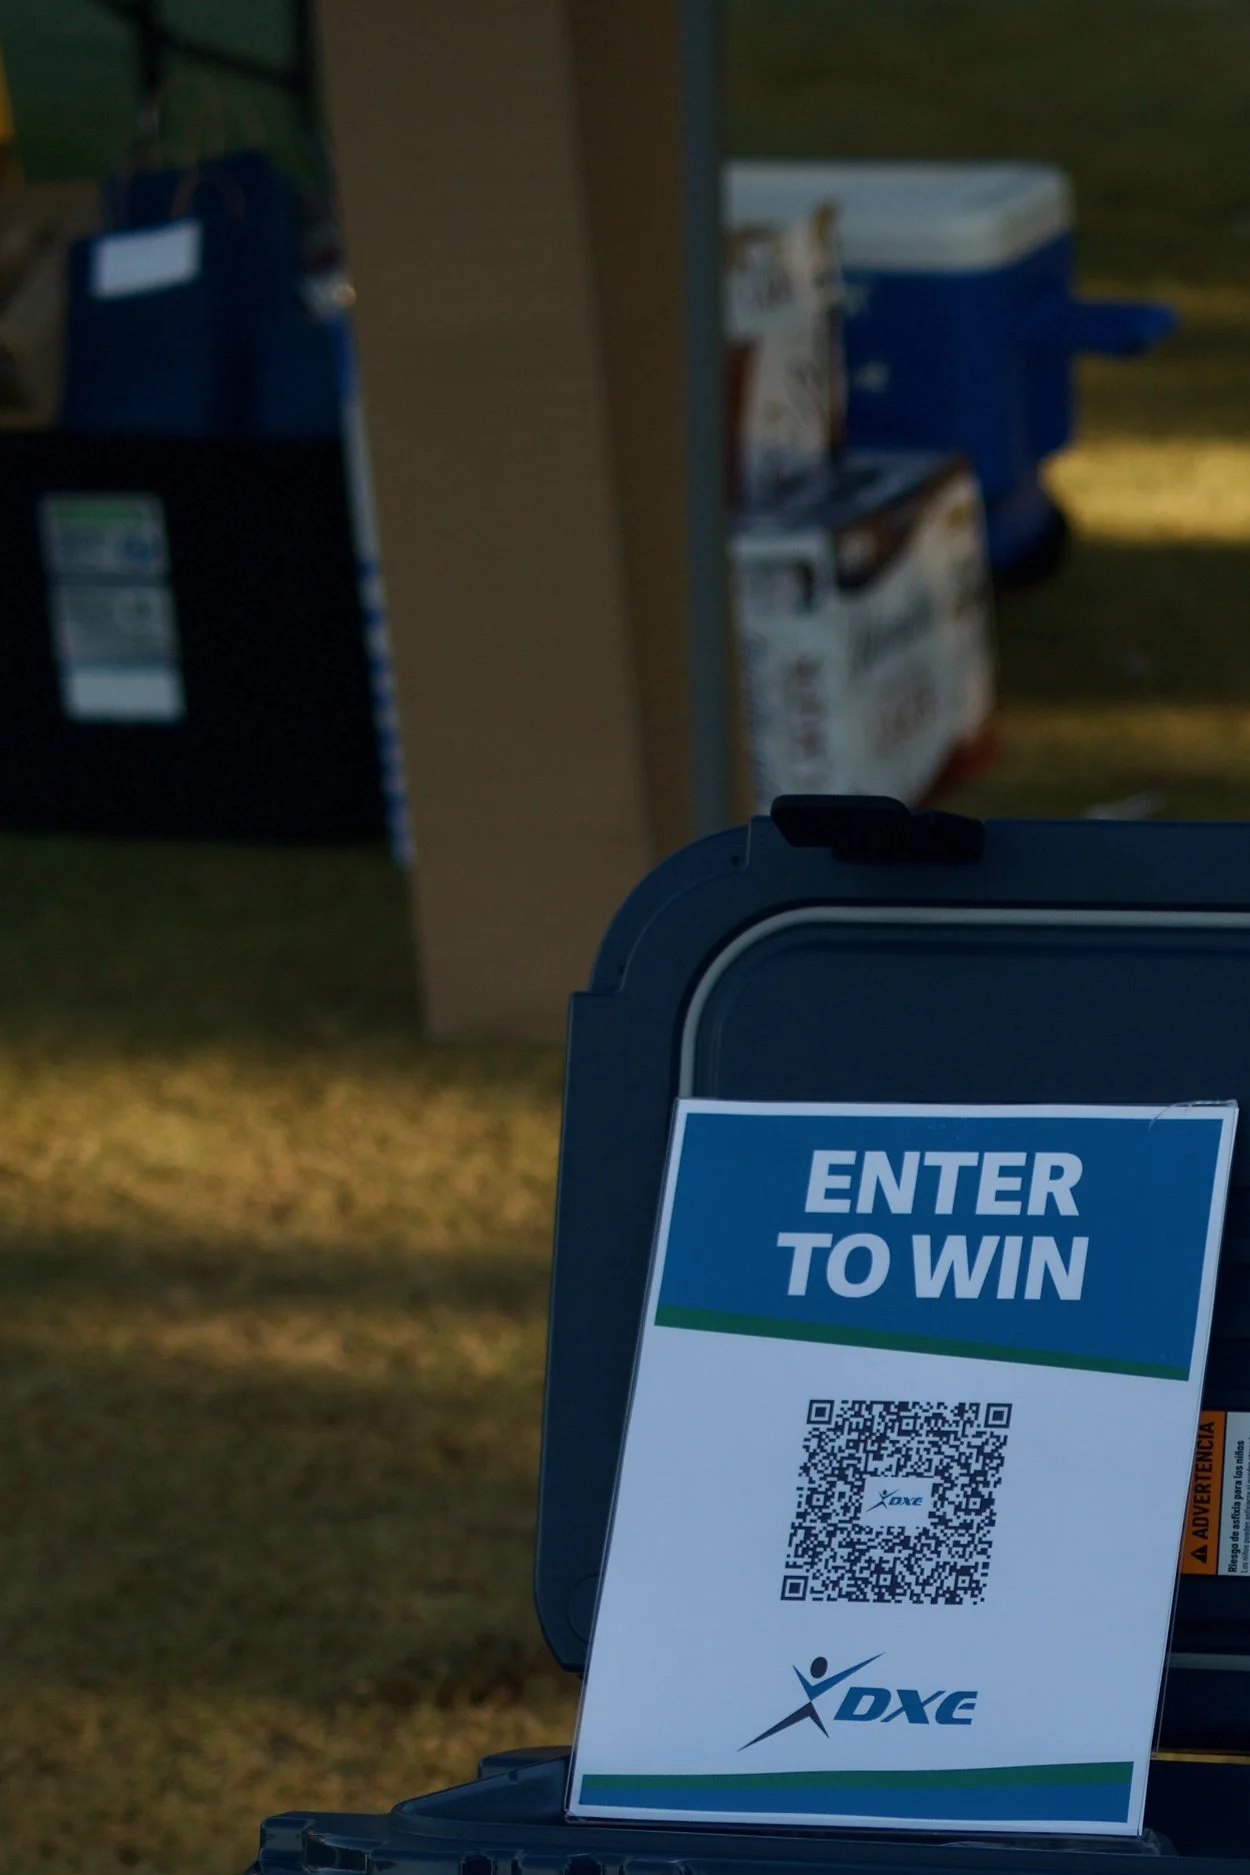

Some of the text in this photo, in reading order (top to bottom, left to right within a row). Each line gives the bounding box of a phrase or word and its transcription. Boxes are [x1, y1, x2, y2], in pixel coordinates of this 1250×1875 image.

[804, 1148, 1084, 1217] ENTER
[776, 1231, 1089, 1301] TO WIN
[889, 1497, 922, 1506] DXE
[1190, 1421, 1214, 1539] ADVERTENCIA
[1227, 1440, 1244, 1572] Riesgo de asfixia para los niños
[834, 1687, 978, 1725] DXE
